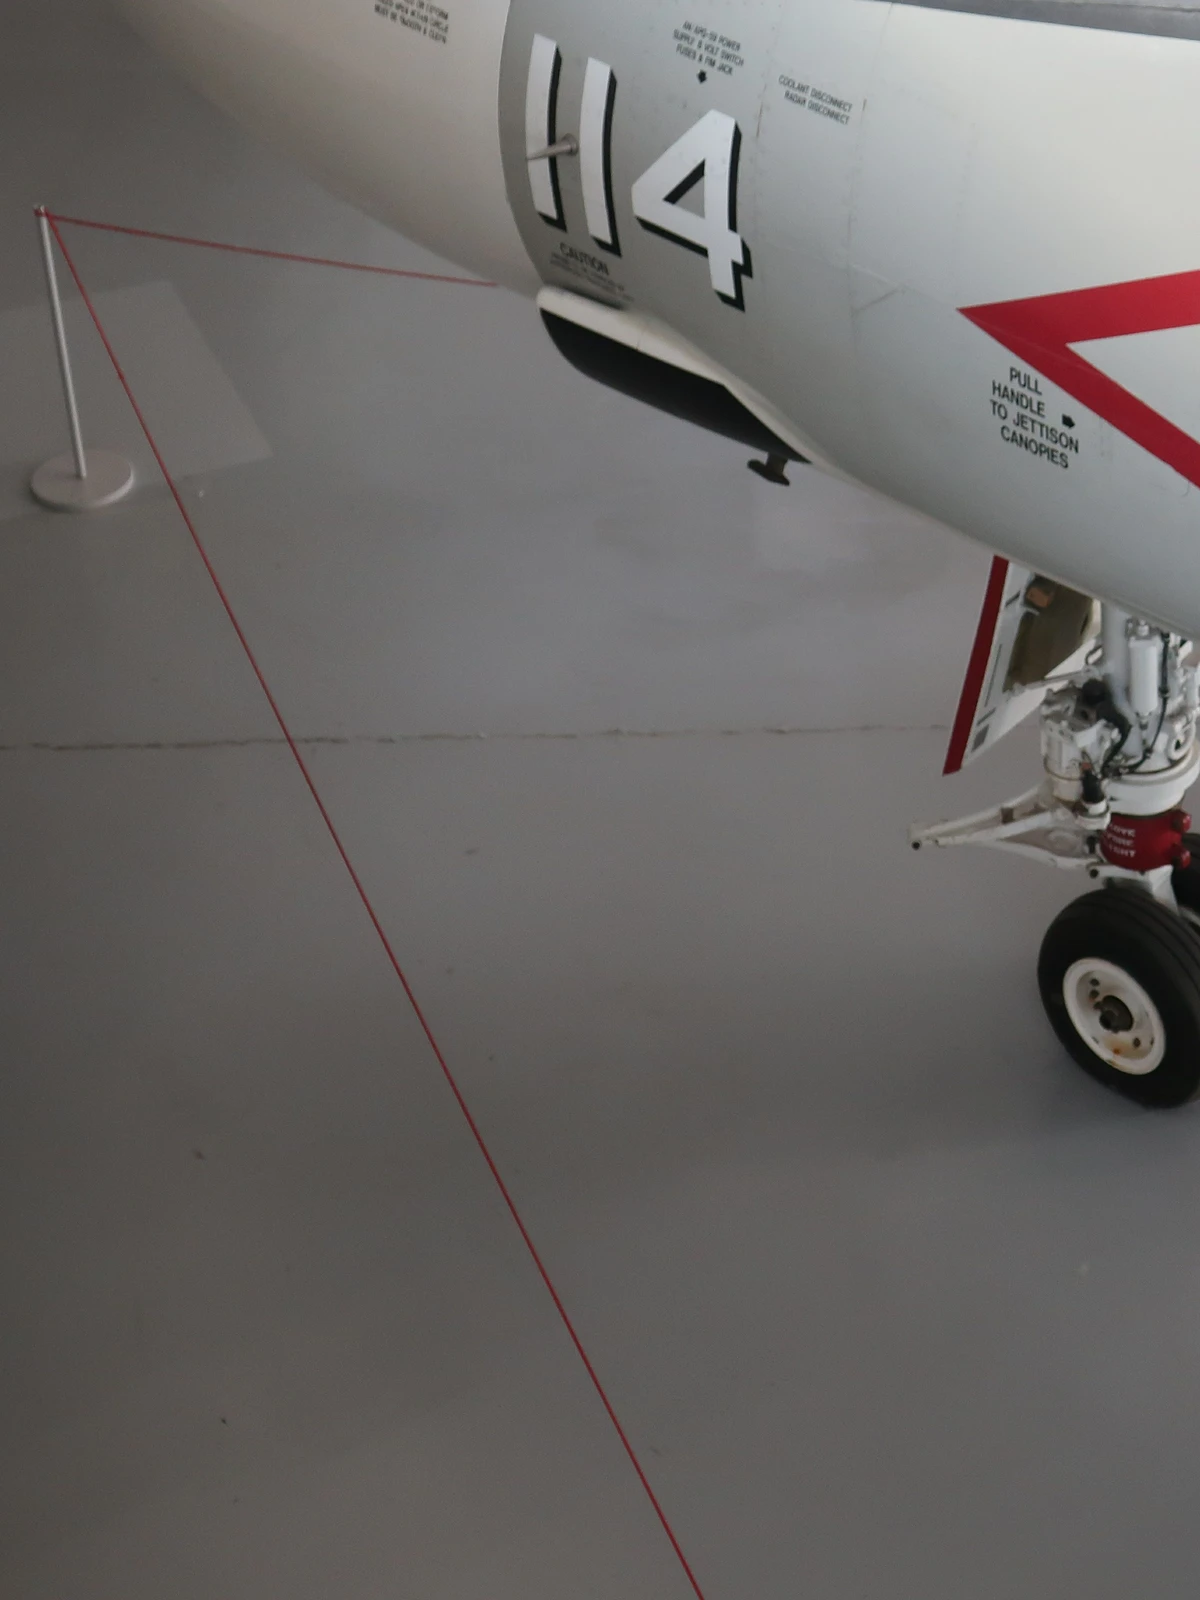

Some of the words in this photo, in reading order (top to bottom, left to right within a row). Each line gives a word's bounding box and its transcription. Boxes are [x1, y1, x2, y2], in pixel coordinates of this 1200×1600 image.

[720, 49, 745, 67] SWITCH
[778, 74, 810, 95] COOLANT
[810, 86, 853, 114] DISCONNECT
[784, 89, 807, 108] RADAR
[807, 99, 850, 126] DISCONNECT
[525, 34, 752, 312] 114
[992, 380, 1046, 418] HANDLE
[1010, 366, 1042, 396] PULL
[990, 399, 1007, 420] TO
[1013, 411, 1079, 454] JETTISON
[1001, 425, 1069, 469] CANOPIES
